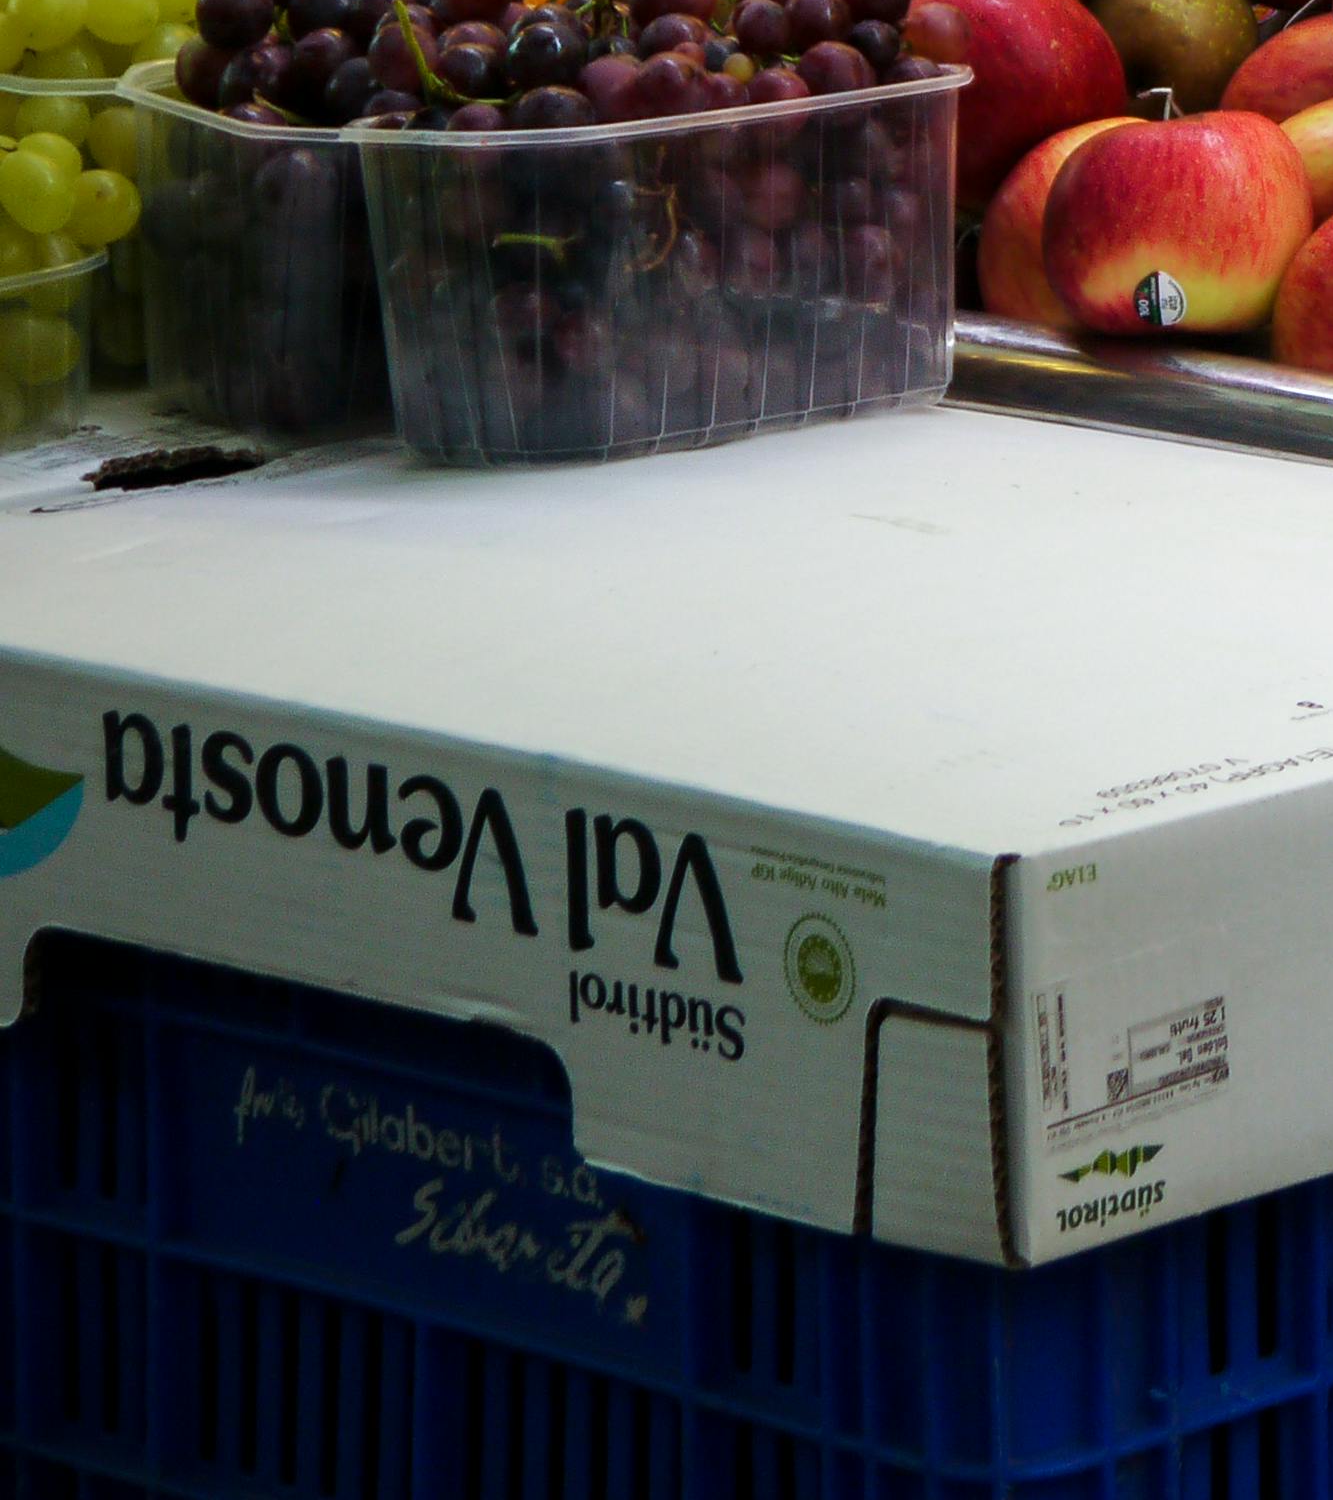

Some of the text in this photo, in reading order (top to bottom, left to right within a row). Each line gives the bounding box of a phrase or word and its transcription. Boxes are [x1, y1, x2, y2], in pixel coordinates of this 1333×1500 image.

[103, 709, 743, 984] Val Venosta
[569, 969, 747, 1062] Südtirol
